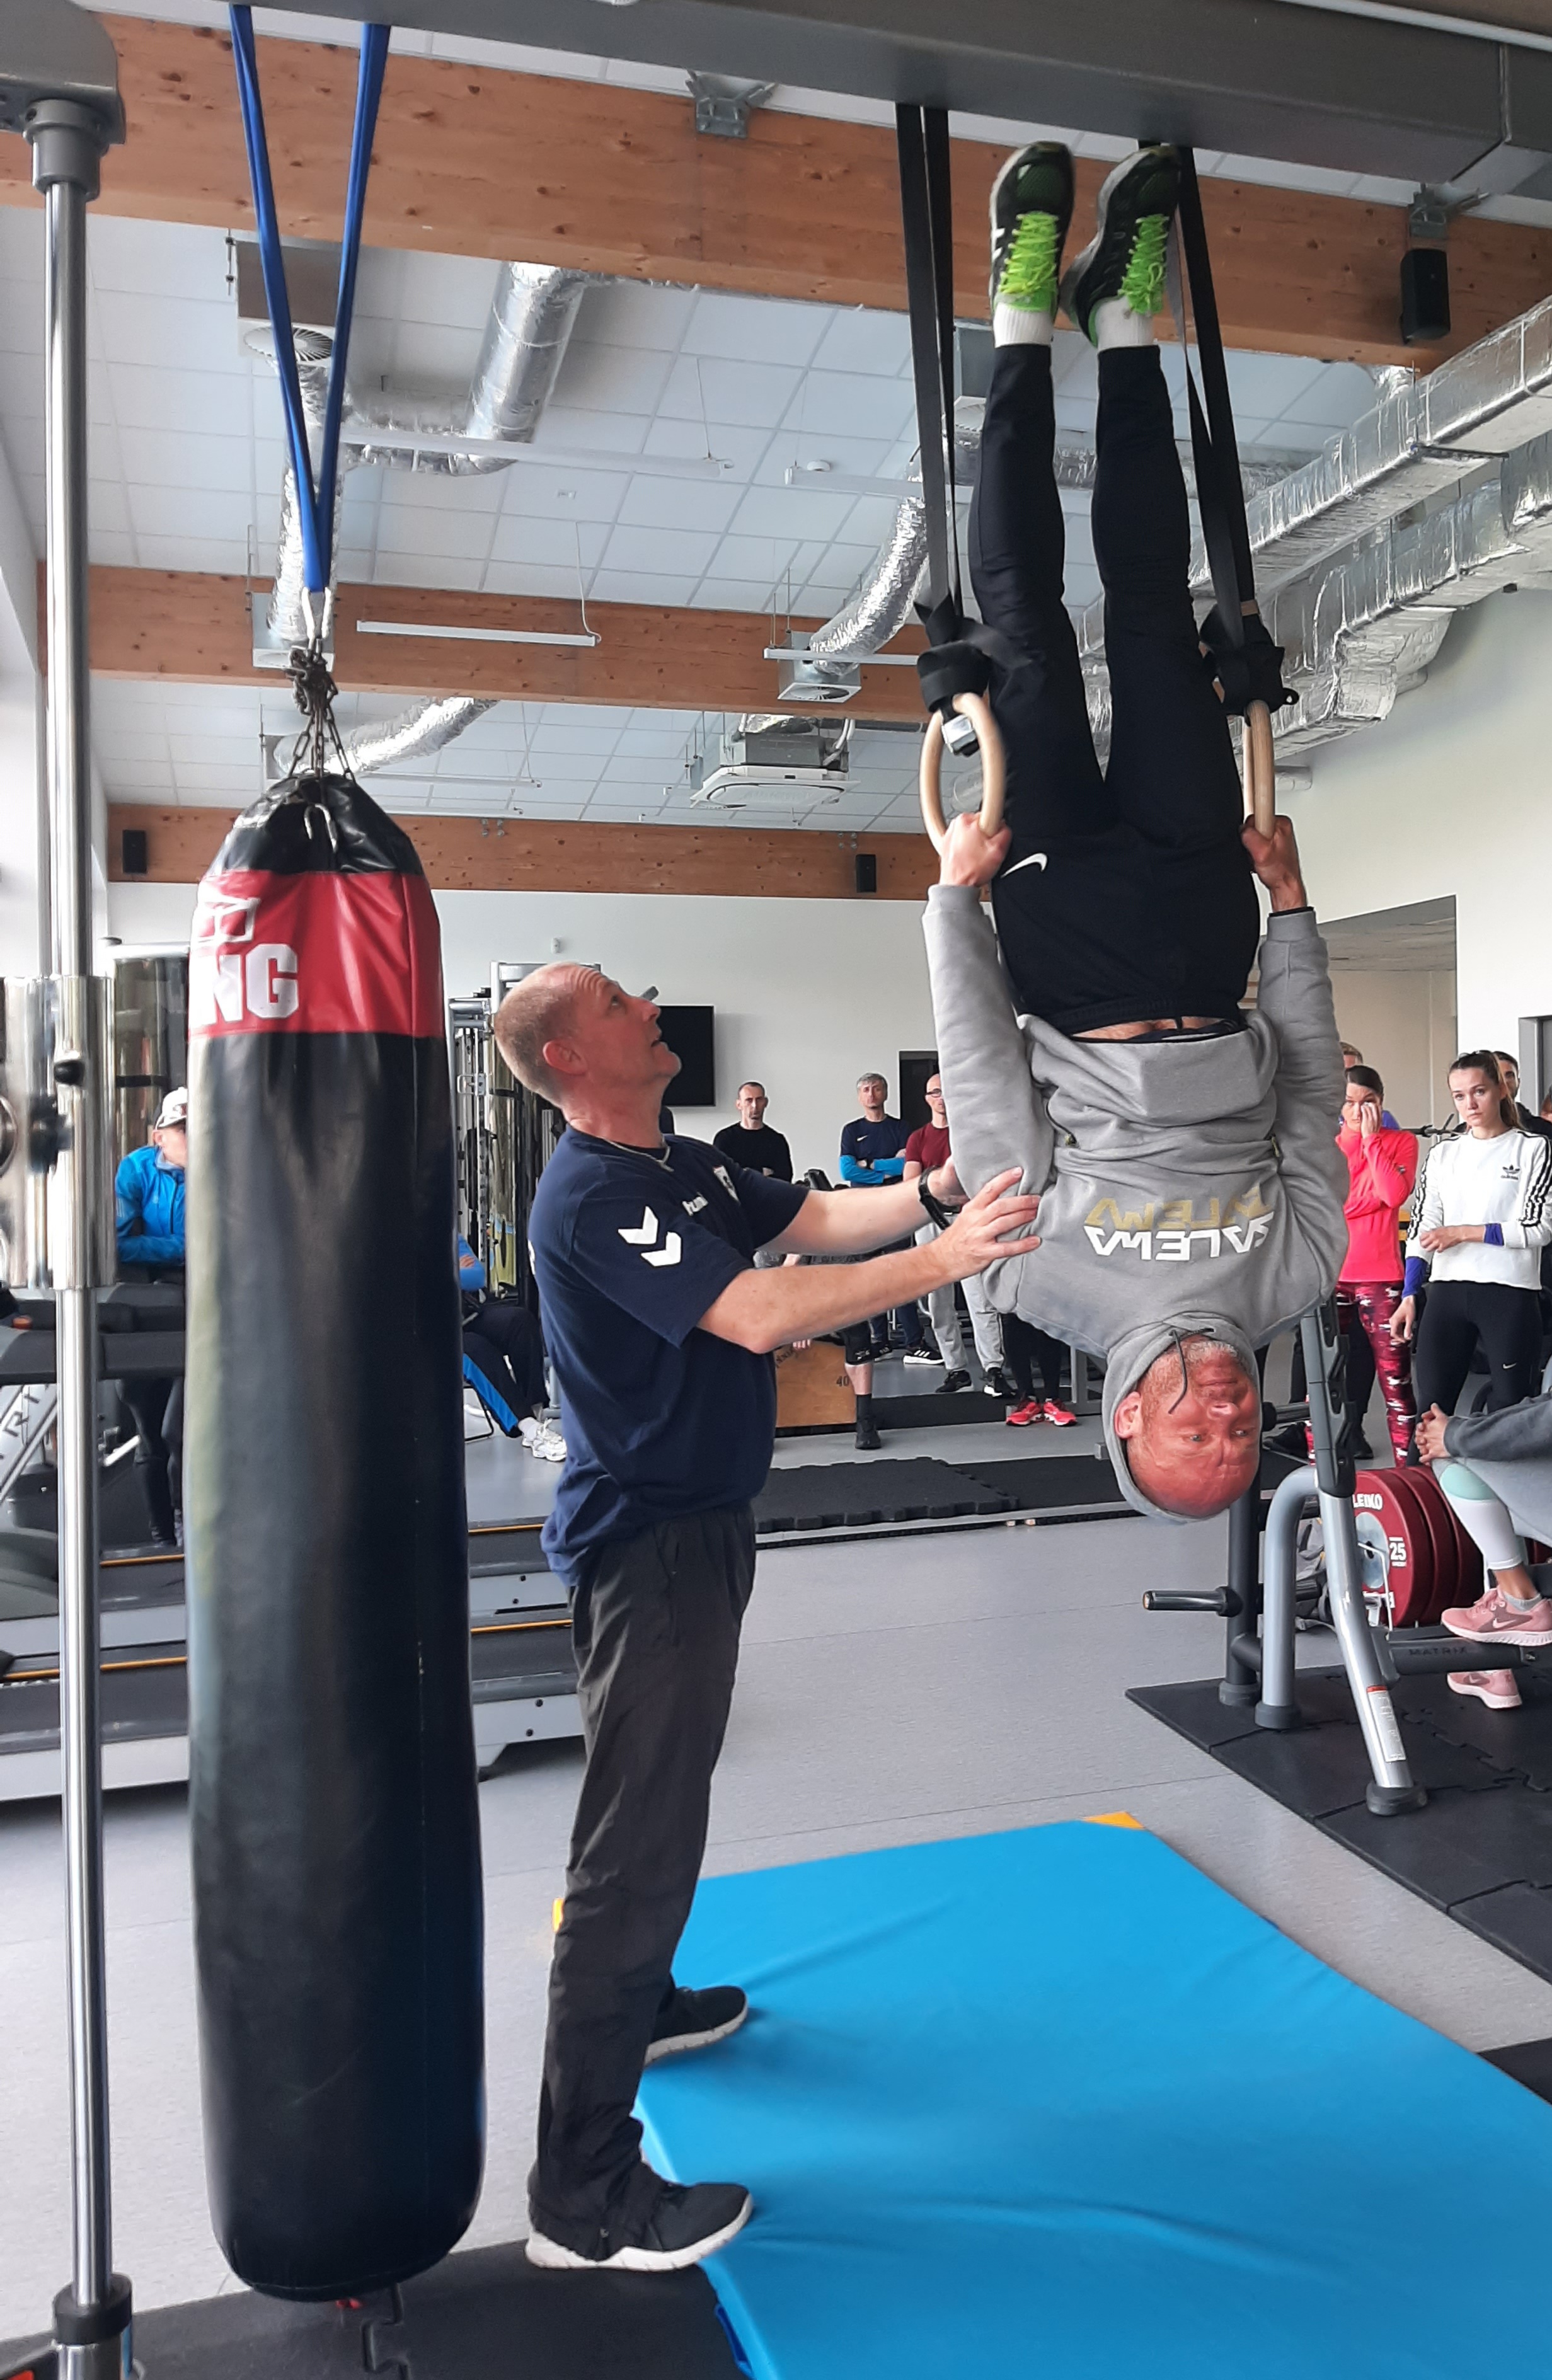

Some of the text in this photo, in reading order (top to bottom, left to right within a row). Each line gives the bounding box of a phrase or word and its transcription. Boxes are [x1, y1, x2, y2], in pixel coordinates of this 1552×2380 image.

[1083, 1211, 1274, 1261] SALEWA
[836, 1375, 850, 1387] 40
[1352, 1493, 1383, 1510] LEIKO
[1389, 1542, 1406, 1561] 25
